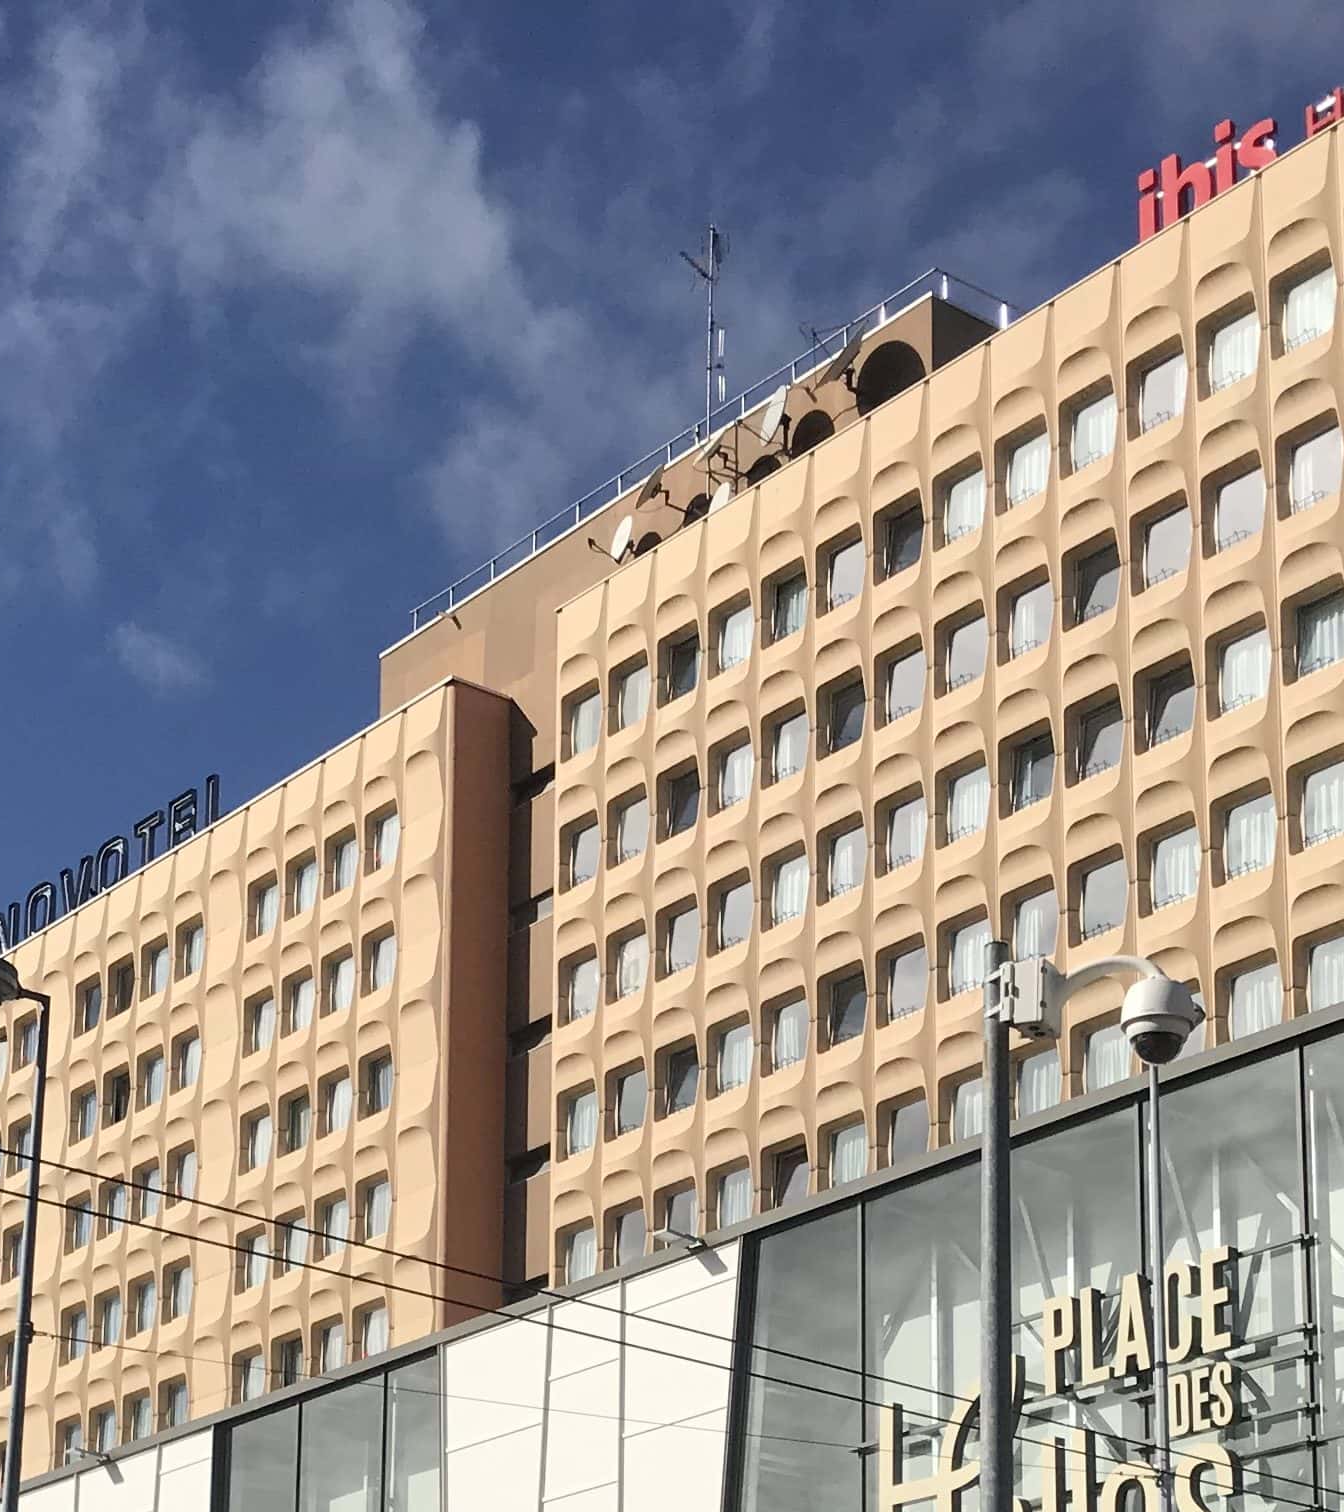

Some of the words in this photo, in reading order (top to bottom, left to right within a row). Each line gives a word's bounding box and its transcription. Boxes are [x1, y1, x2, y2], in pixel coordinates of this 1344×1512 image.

[1137, 117, 1278, 242] ibis
[1043, 1245, 1236, 1396] PLACE
[1169, 1361, 1236, 1438] DES
